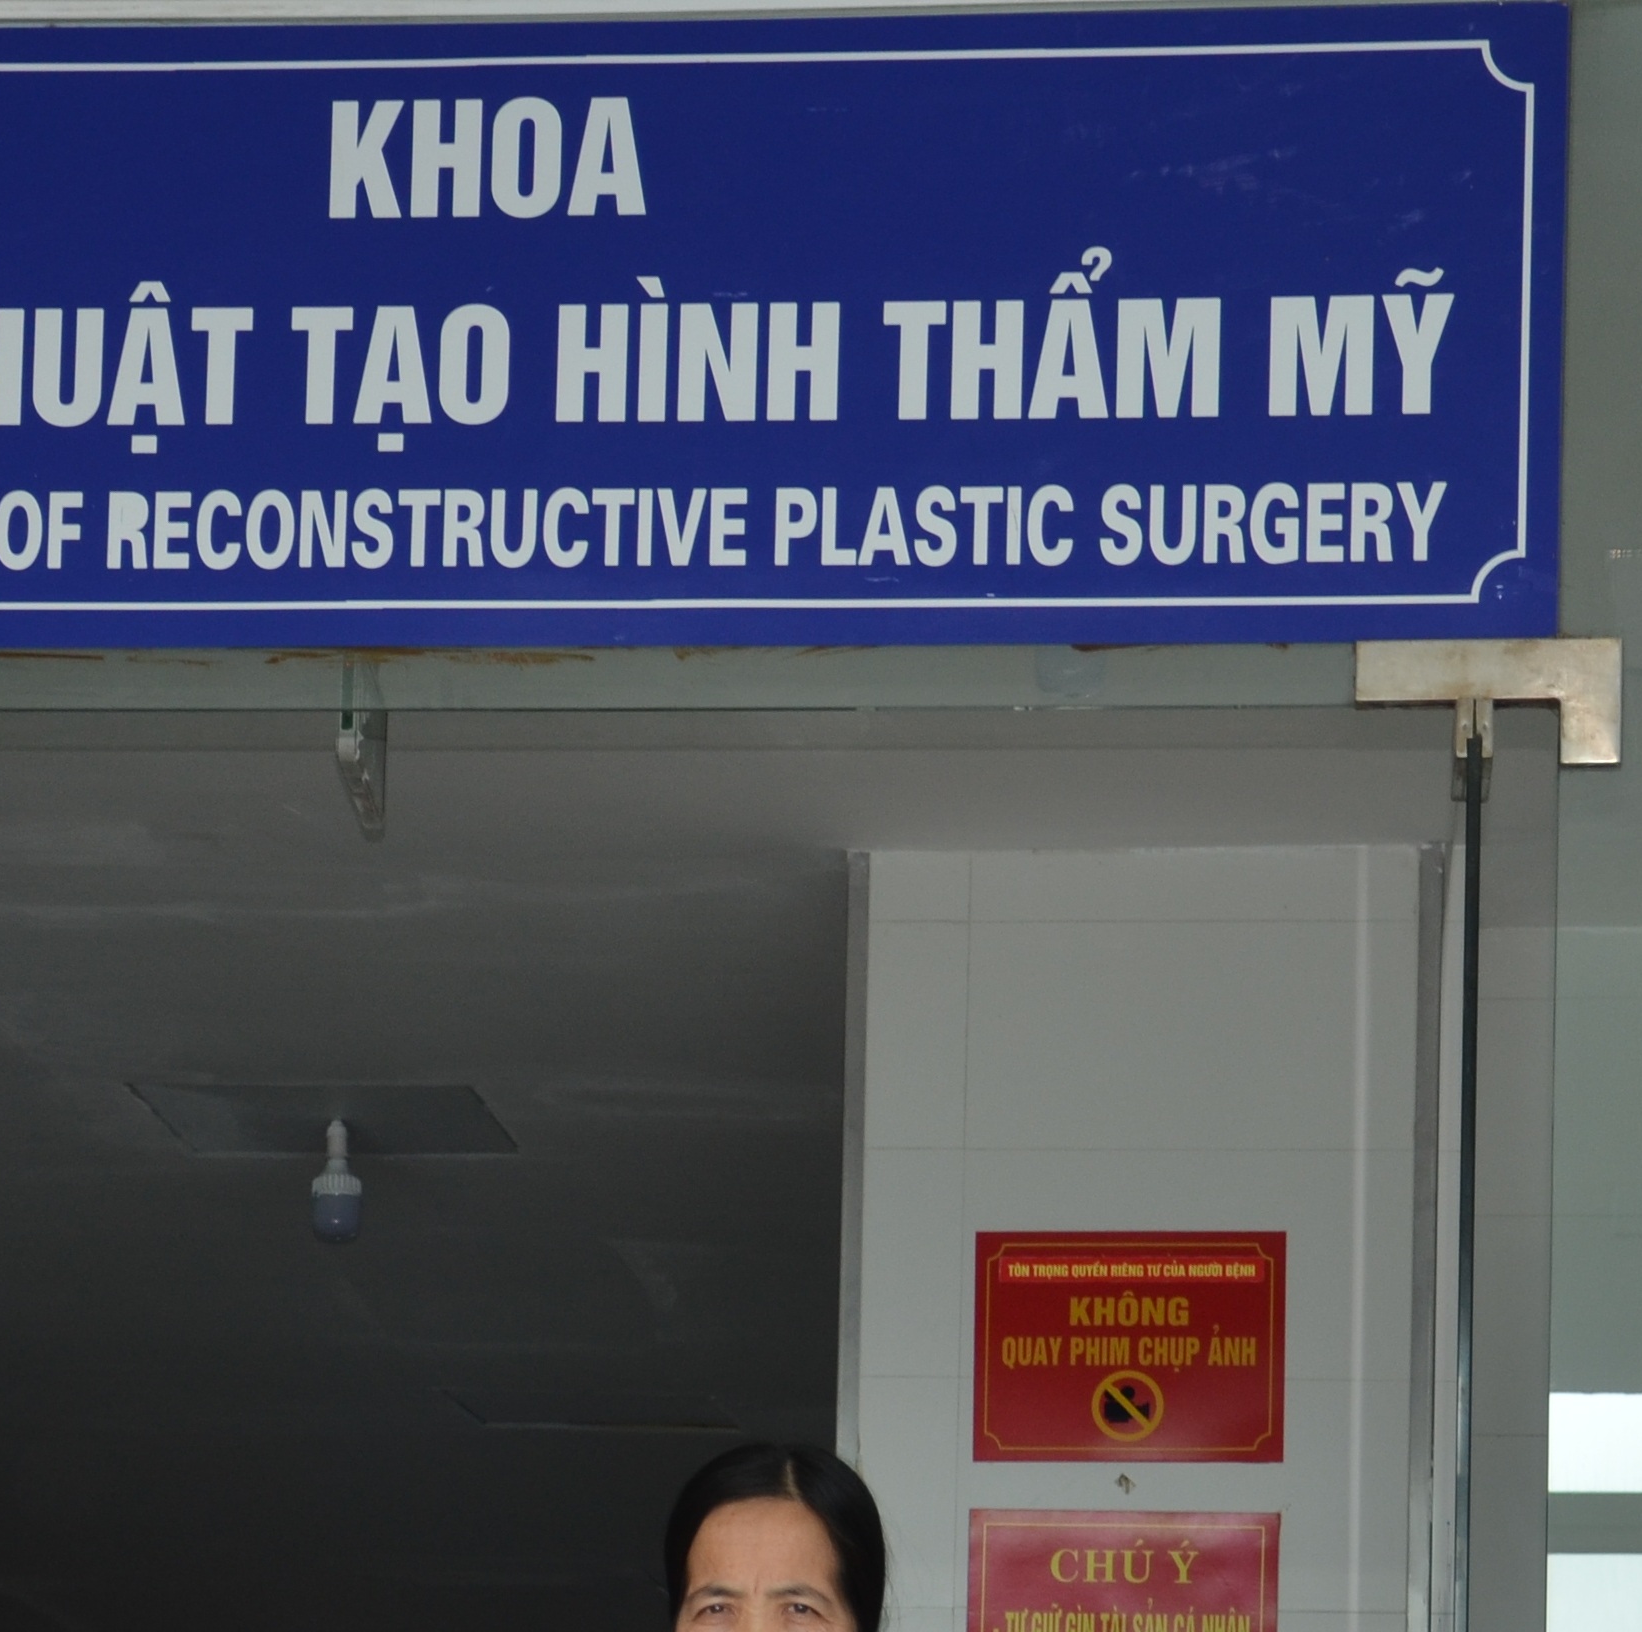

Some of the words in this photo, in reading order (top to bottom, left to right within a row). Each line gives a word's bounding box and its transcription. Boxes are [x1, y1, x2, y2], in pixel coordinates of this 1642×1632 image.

[329, 97, 646, 218] KHOA
[292, 304, 510, 451] TẠO
[556, 277, 840, 422] HÌNH
[883, 247, 1221, 419] THẨM
[1269, 268, 1454, 416] MỸ
[107, 488, 747, 570] RECONSTRUCTIVE
[775, 485, 1073, 566] PLASTIC
[1100, 482, 1447, 565] SURGERY
[1033, 1264, 1069, 1280] TRỌNG
[1110, 1262, 1144, 1277] RIÊNG
[1147, 1263, 1161, 1277] TƯ
[1163, 1259, 1186, 1277] CỦA
[1225, 1262, 1256, 1280] BỆNH
[1069, 1291, 1189, 1326] KHÔNG
[1002, 1336, 1062, 1369] QUAY
[1070, 1336, 1130, 1366] PHIM
[1138, 1336, 1200, 1372] CHỤP
[1208, 1324, 1256, 1366] ẢNH
[1050, 1539, 1154, 1583] CHÚ
[1168, 1540, 1199, 1584] Ý
